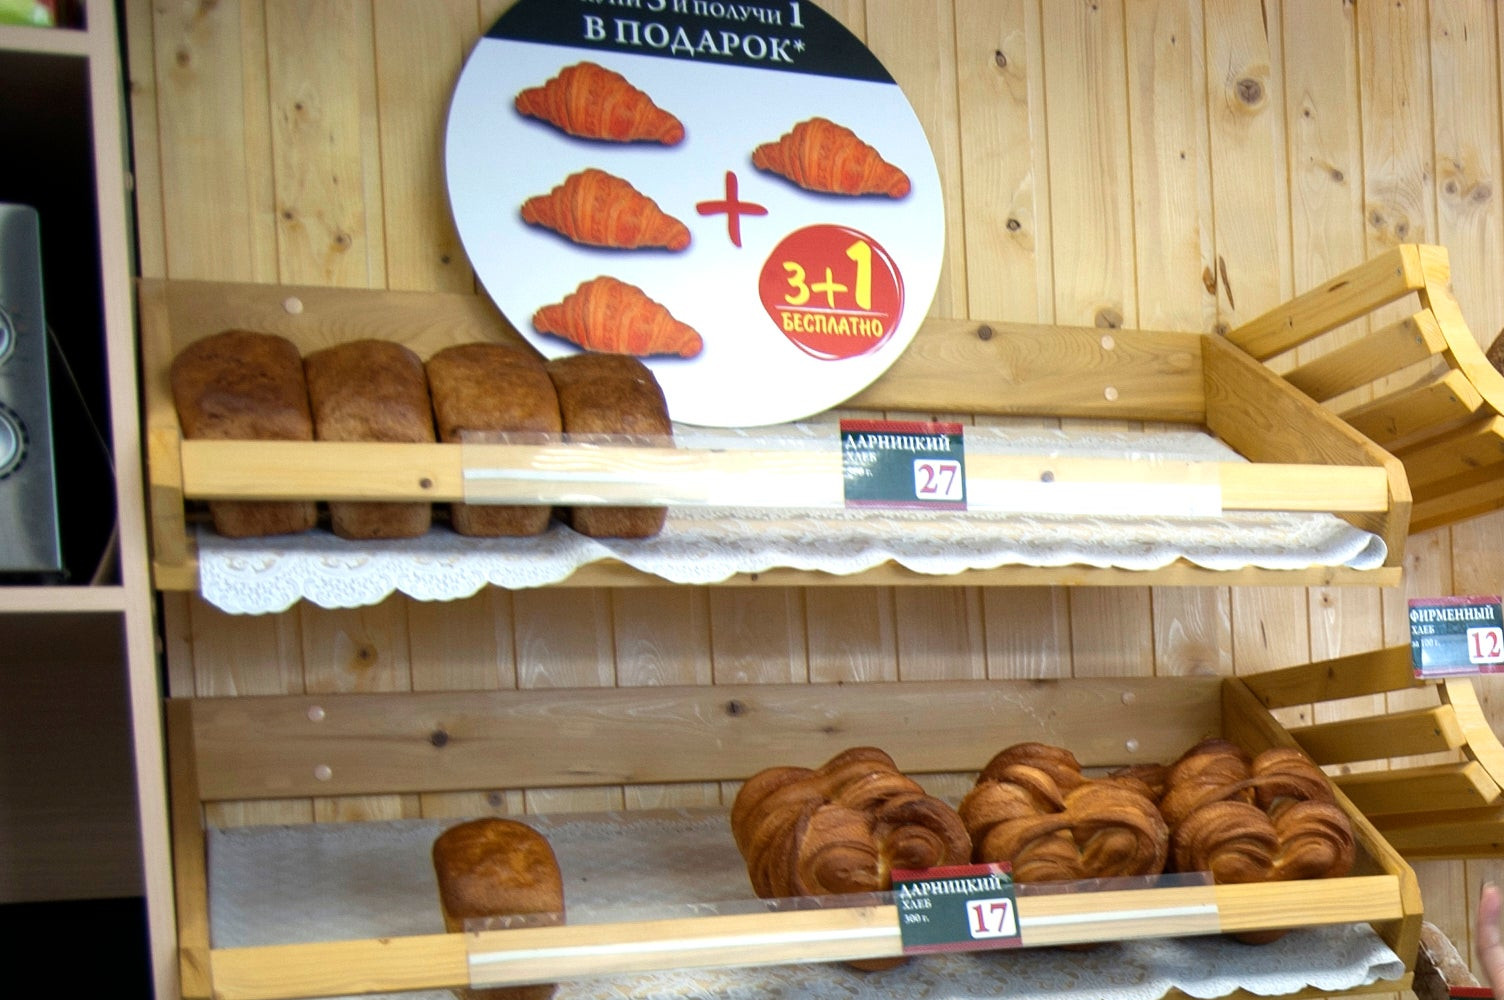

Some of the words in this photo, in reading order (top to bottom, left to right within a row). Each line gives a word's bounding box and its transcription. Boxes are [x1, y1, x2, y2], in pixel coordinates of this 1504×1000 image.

[583, 15, 606, 41] В
[692, 1, 782, 26] ПОЛУЧИ
[789, 1, 805, 29] 1
[783, 240, 872, 311] 3+1
[781, 312, 884, 339] БЕСПЛАТНО
[845, 433, 951, 454] ДАРНИЦКИЙ
[918, 463, 958, 496] 27
[1410, 604, 1495, 622] ФИРМЕННЫЙ
[1411, 625, 1436, 636] ХЛЕБ
[1471, 631, 1502, 659] 12
[900, 874, 1003, 899] ДАРНИЦКИЙ
[902, 898, 932, 911] ХЛЕБ
[972, 902, 1008, 934] 17
